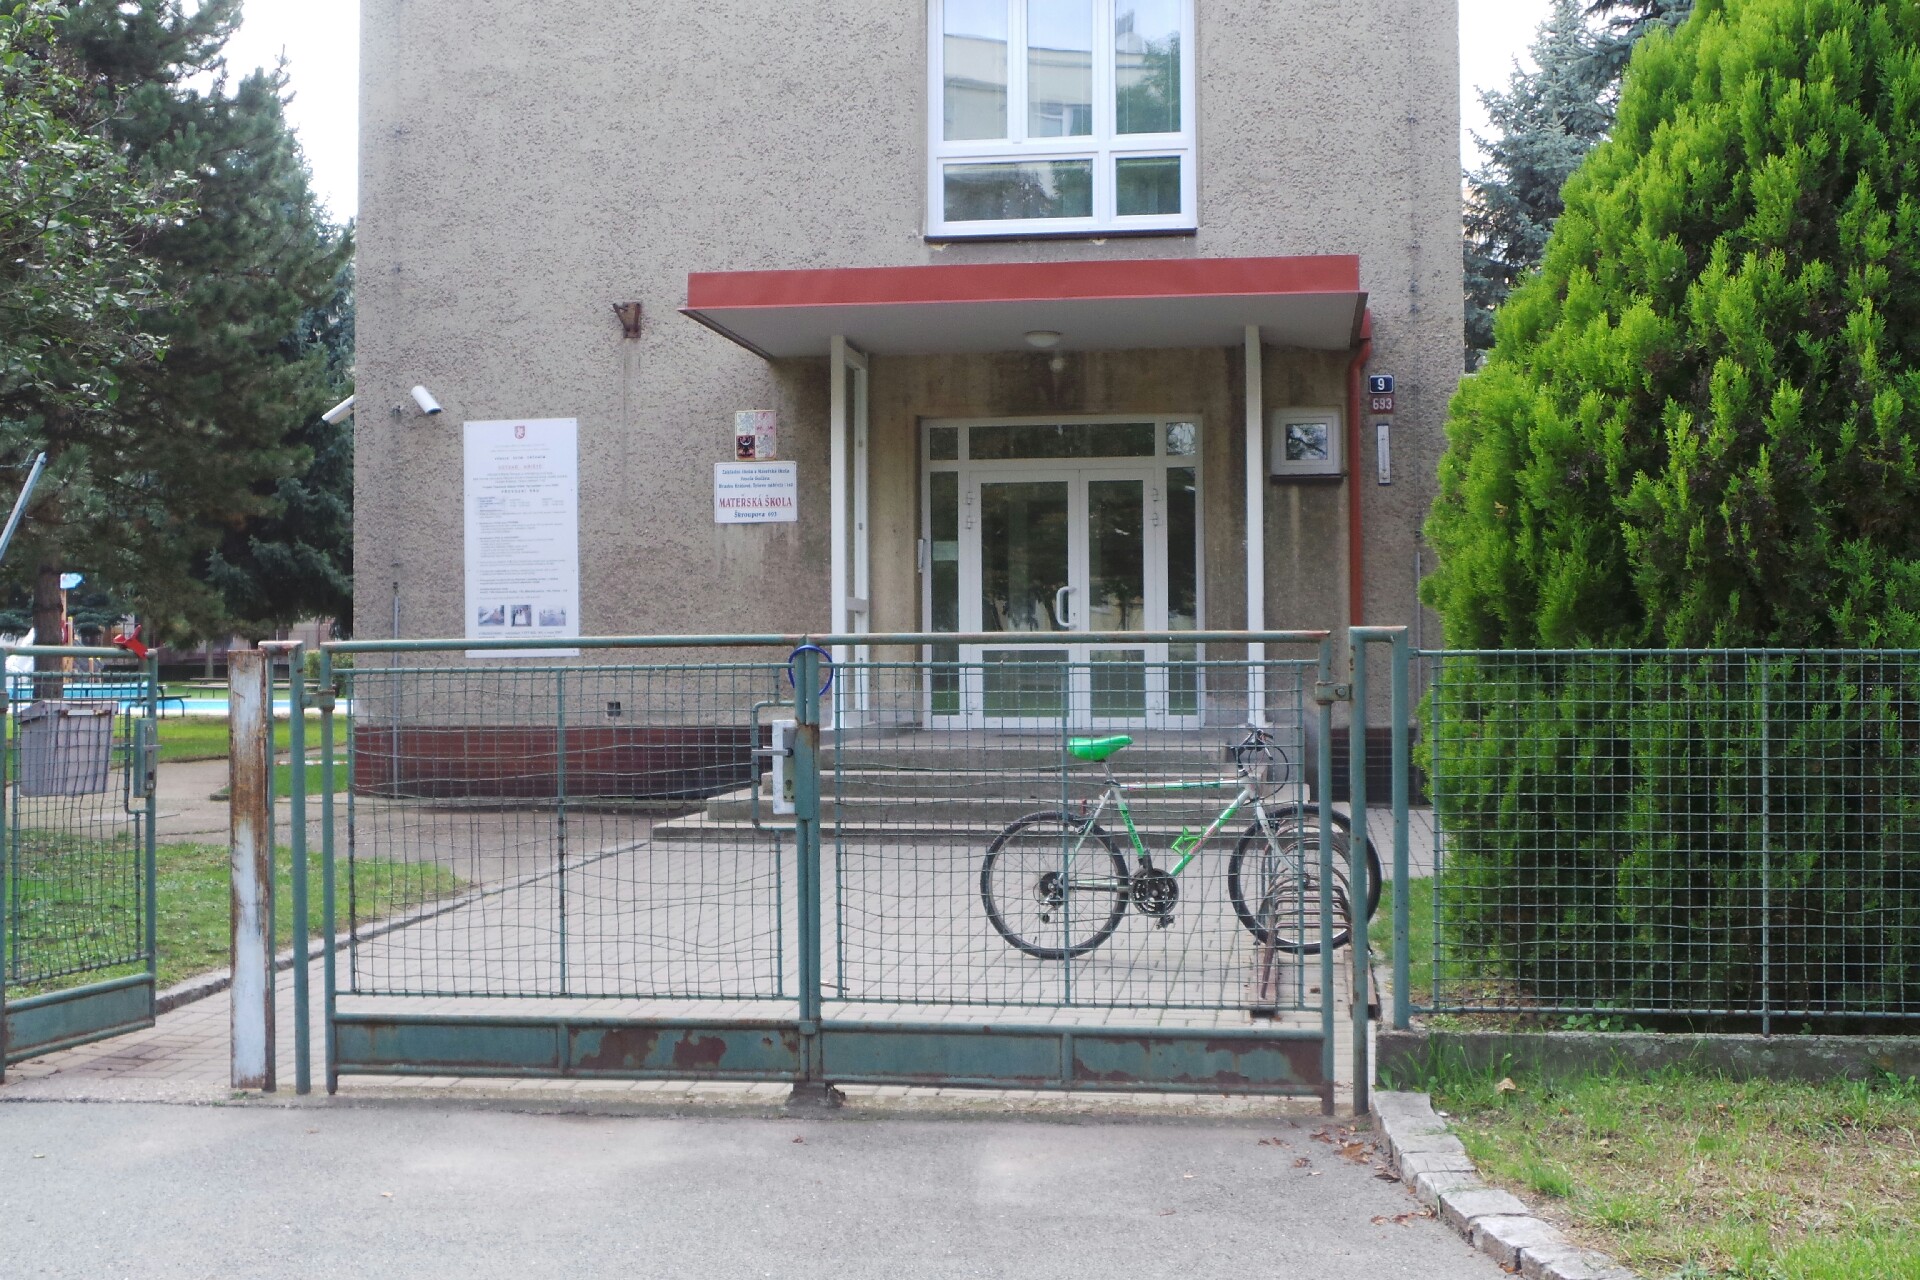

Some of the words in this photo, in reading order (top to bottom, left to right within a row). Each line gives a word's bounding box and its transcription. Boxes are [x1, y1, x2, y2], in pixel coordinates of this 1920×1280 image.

[1377, 378, 1385, 390] 9
[1372, 398, 1392, 410] 693
[718, 494, 763, 508] MATEŘSKÁ
[765, 494, 792, 507] ŠKOLA
[734, 510, 765, 518] Škroupova
